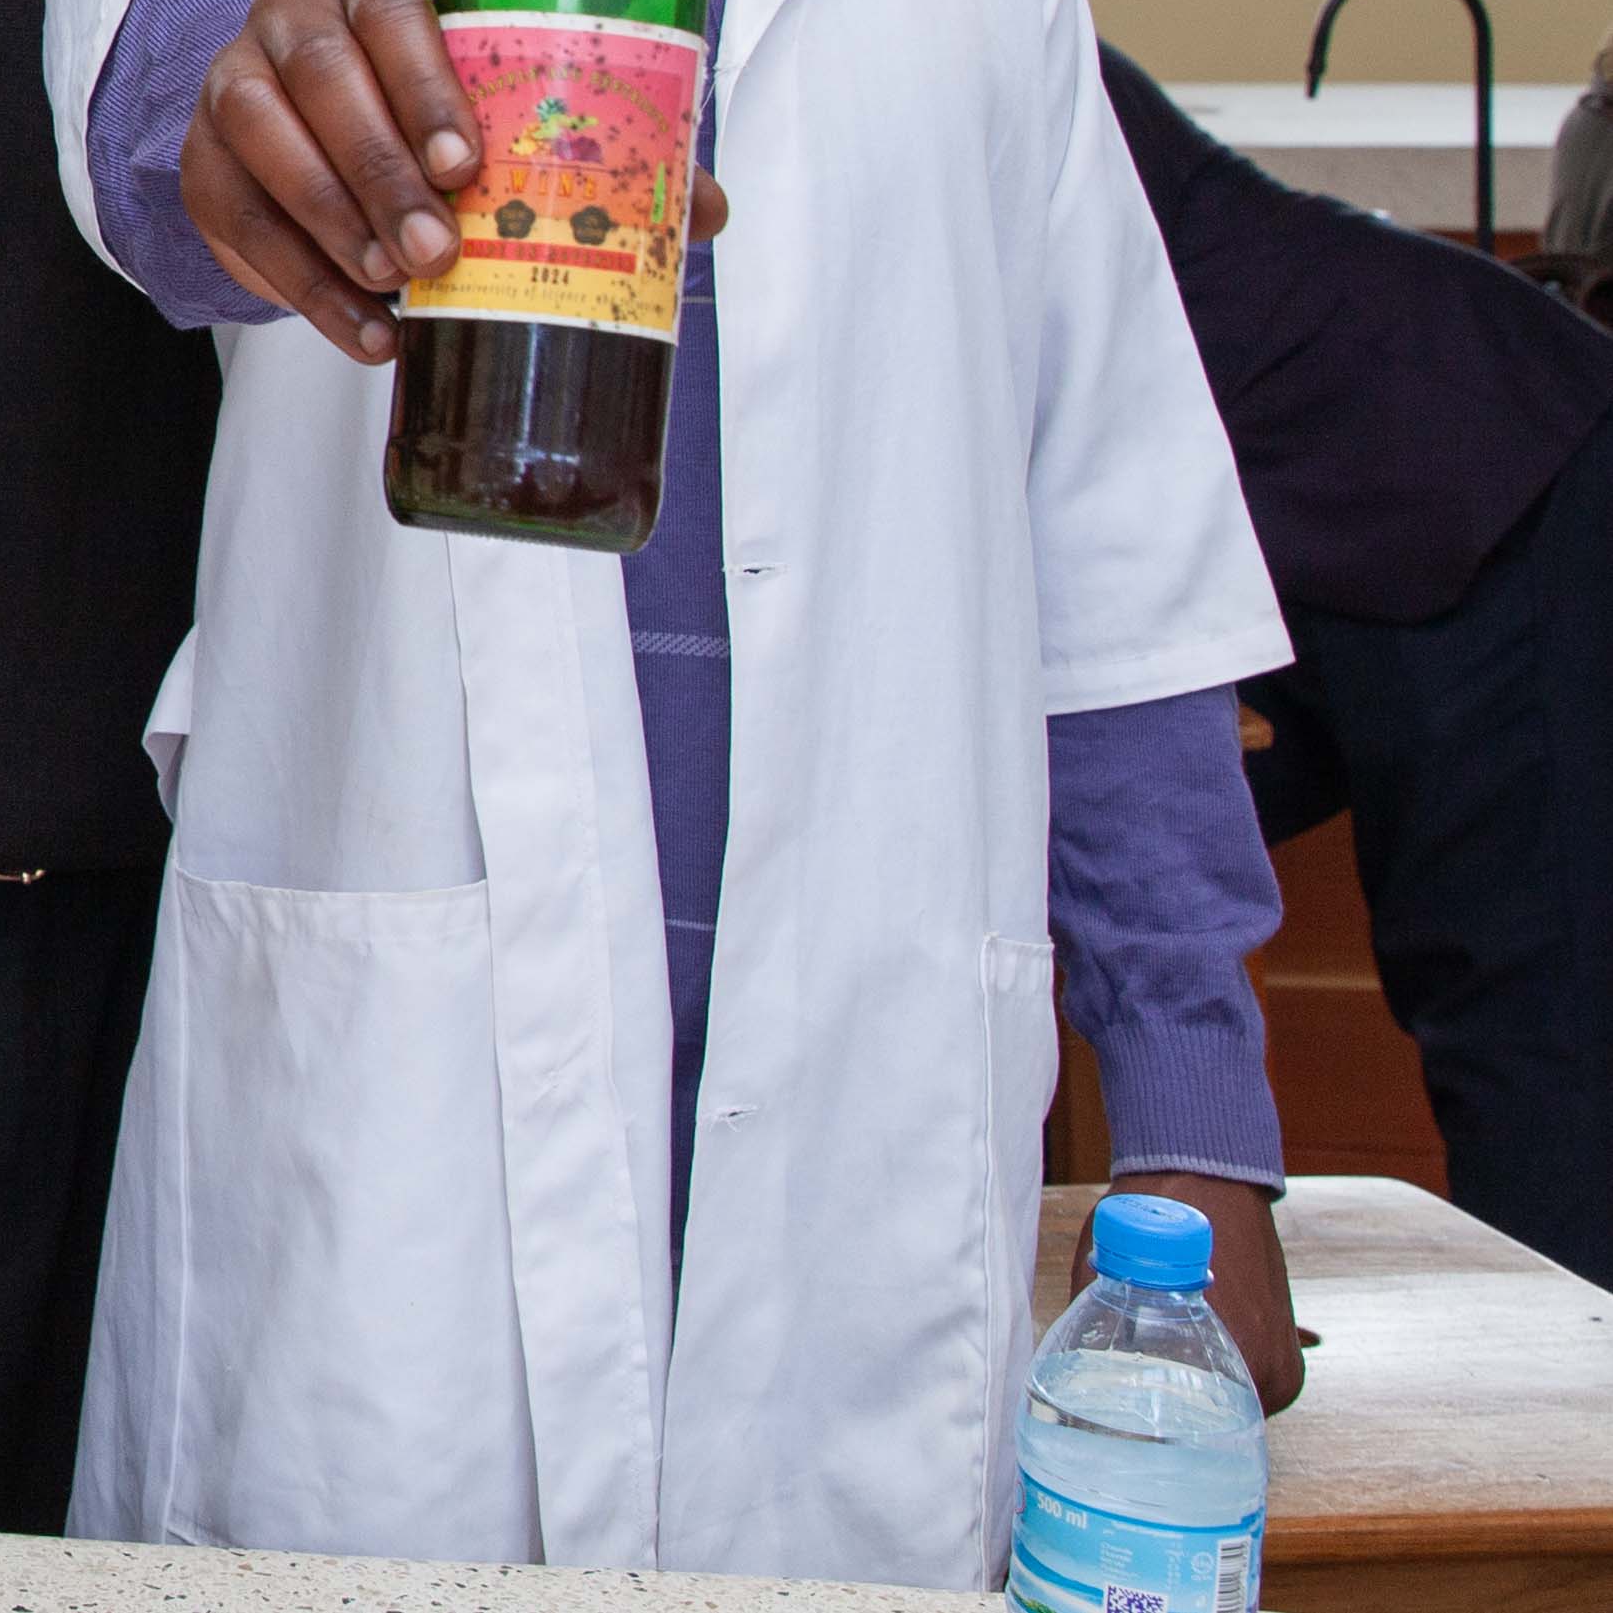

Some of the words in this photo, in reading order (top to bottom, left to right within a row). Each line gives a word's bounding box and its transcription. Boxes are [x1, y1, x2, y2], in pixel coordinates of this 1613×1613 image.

[510, 169, 598, 200] WINE
[530, 265, 572, 285] 2024
[1036, 1492, 1063, 1519] 500
[1064, 1508, 1088, 1531] ml
